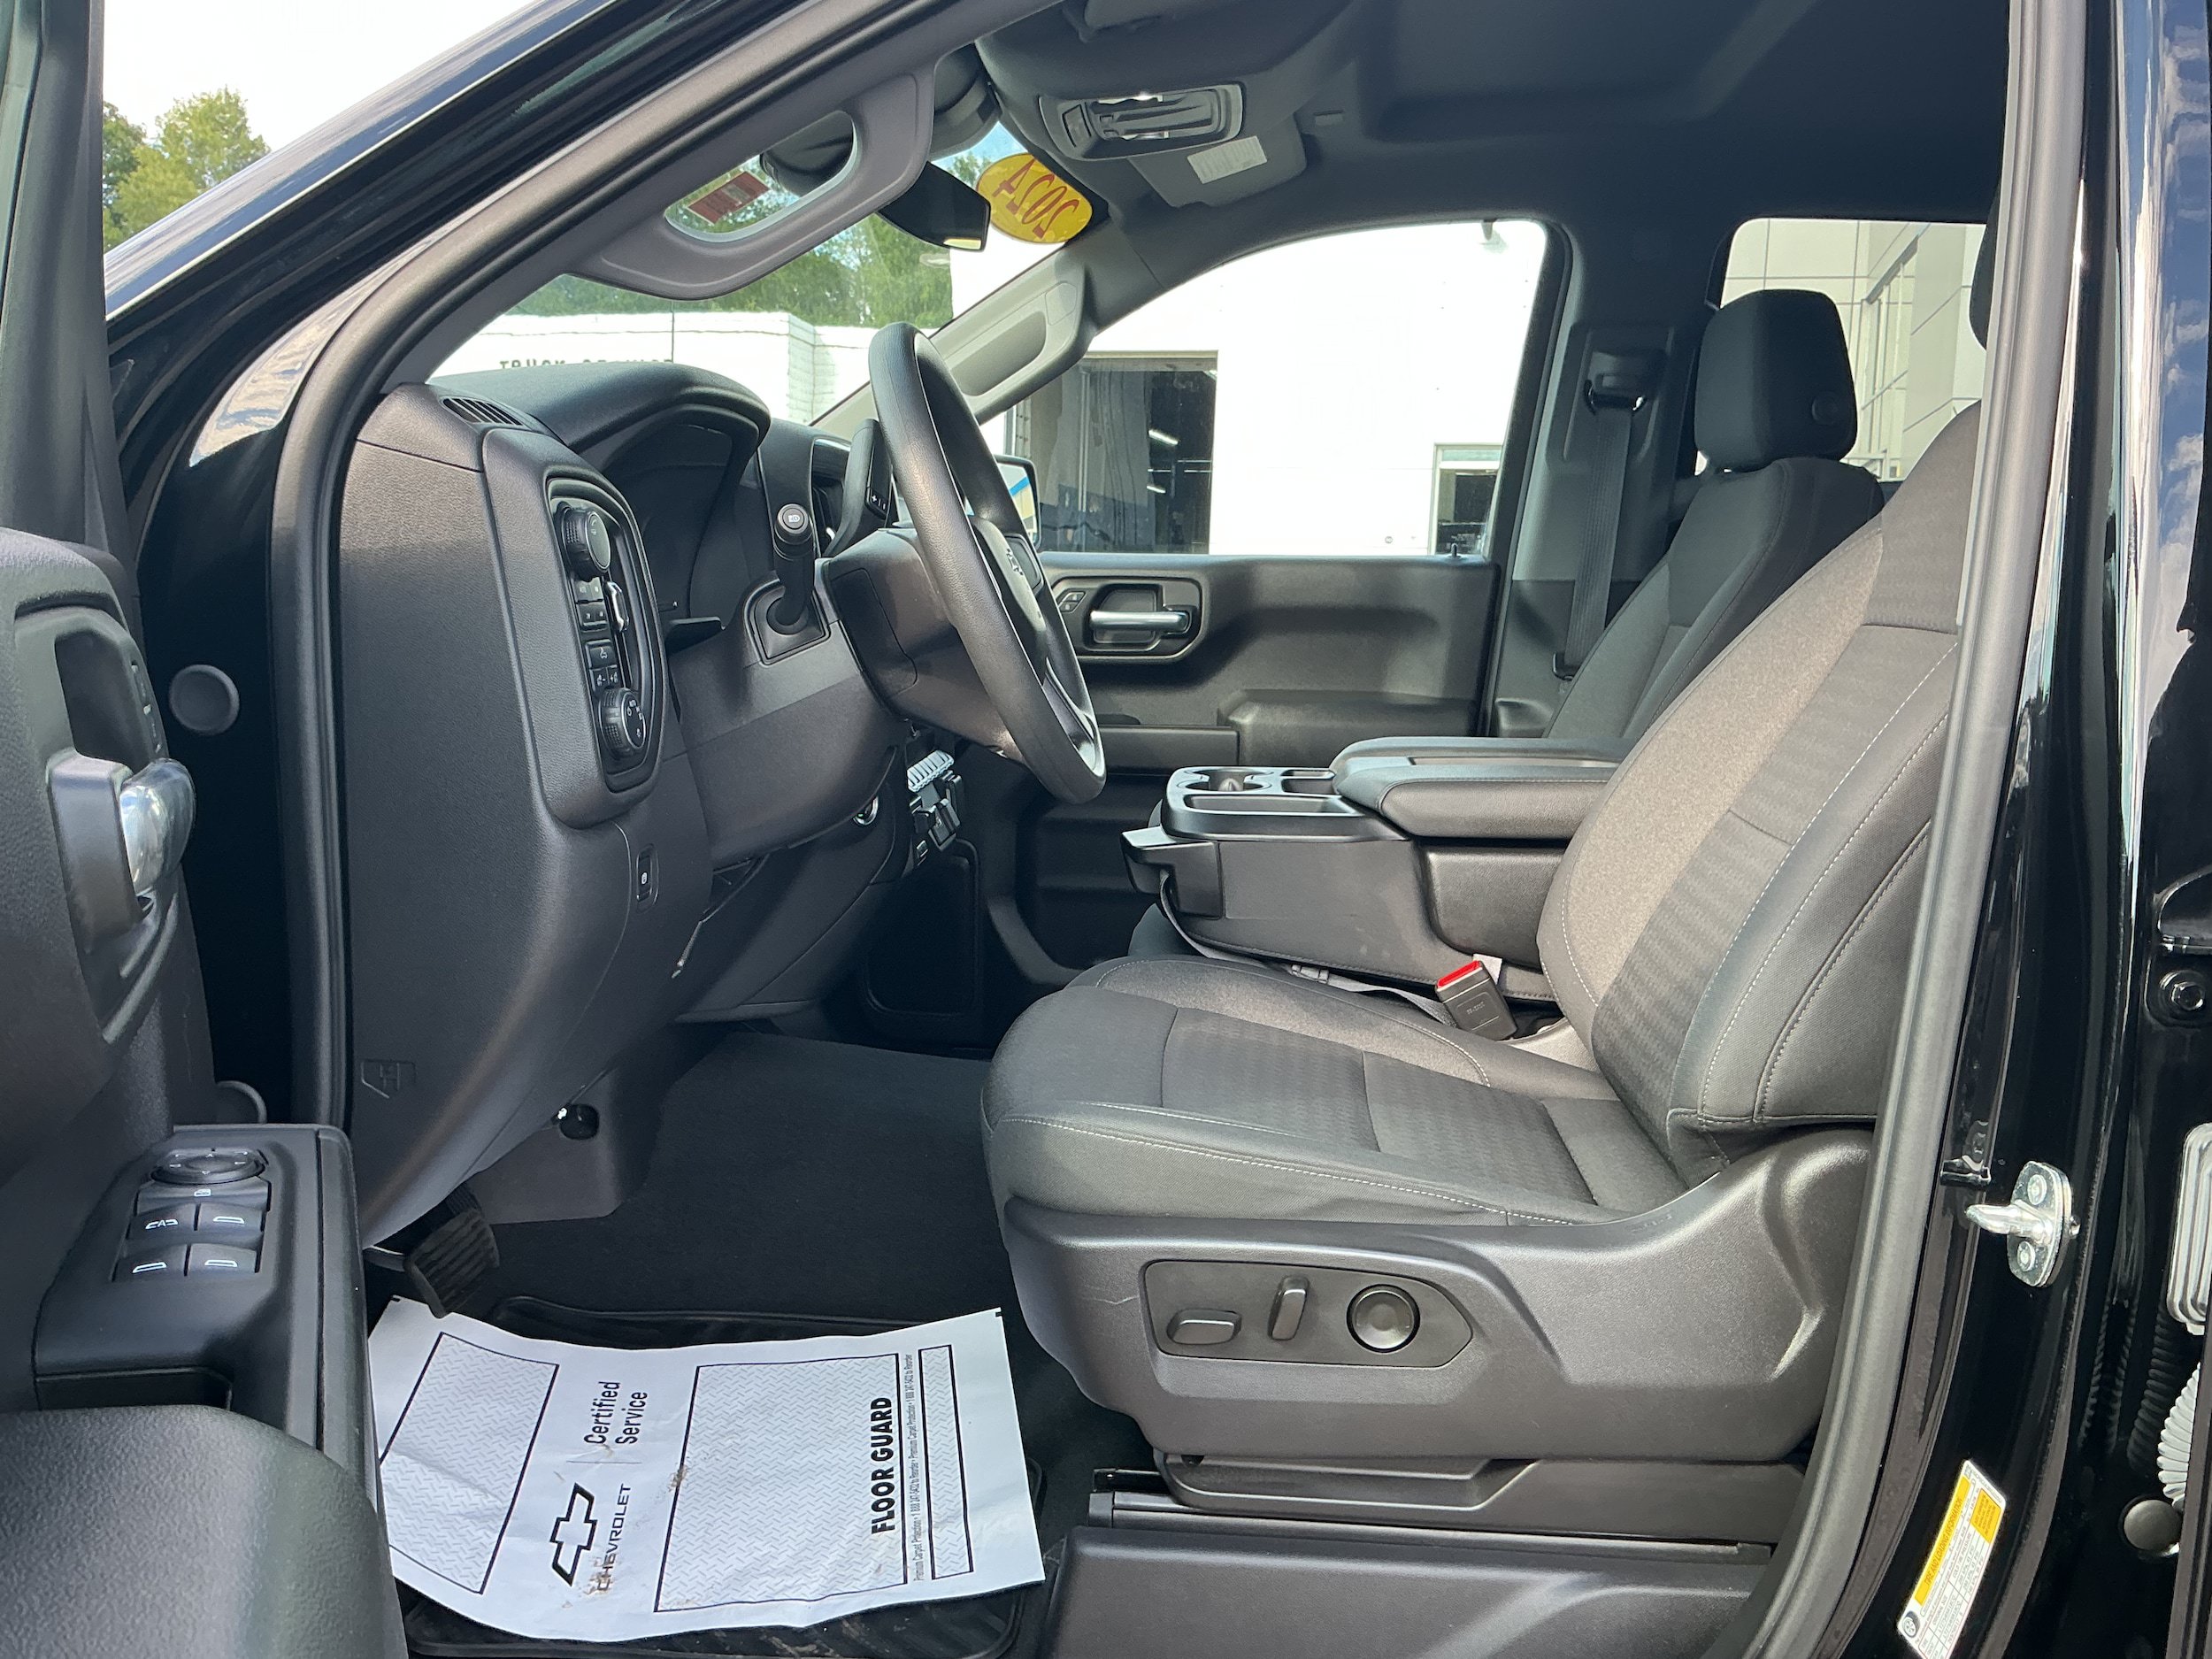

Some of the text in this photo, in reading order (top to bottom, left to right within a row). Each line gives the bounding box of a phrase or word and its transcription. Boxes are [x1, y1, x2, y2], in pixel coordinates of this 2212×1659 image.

[583, 1381, 621, 1444] Certified
[615, 1392, 648, 1444] Service
[906, 1405, 916, 1425] Protection
[908, 1425, 918, 1439] Carpet
[871, 1397, 895, 1534] FLOOR GUARD
[597, 1483, 631, 1591] CHEVROLET
[911, 1520, 921, 1543] Protection
[912, 1543, 925, 1561] Carpet
[913, 1561, 925, 1581] Premium
